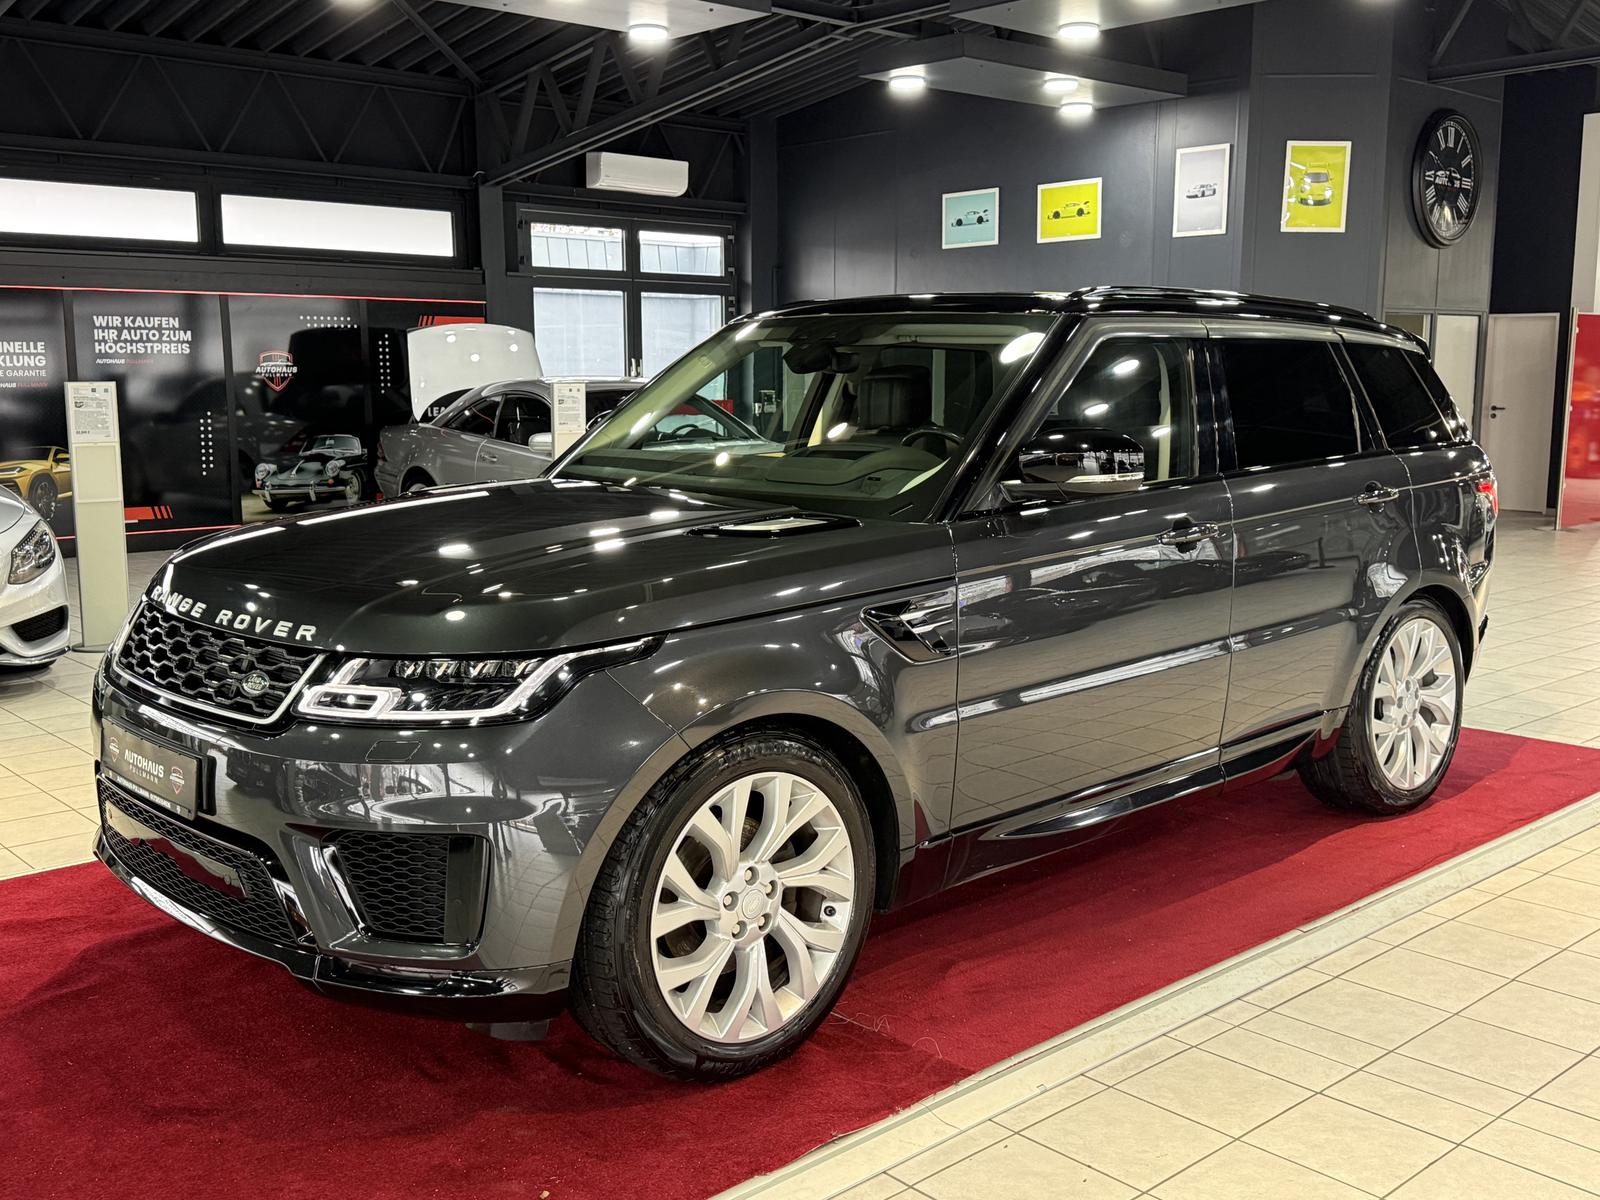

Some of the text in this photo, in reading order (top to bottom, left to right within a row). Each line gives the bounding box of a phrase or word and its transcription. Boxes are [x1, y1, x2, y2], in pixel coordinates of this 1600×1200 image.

[93, 315, 179, 328] WIR KAUFEN
[94, 329, 192, 341] IHR AUTO ZUM
[0, 341, 46, 353] NELLE
[94, 339, 191, 354] HÖCHSTPREIS
[151, 585, 317, 641] RANGE ROVER
[124, 749, 165, 778] AUTOHAUS
